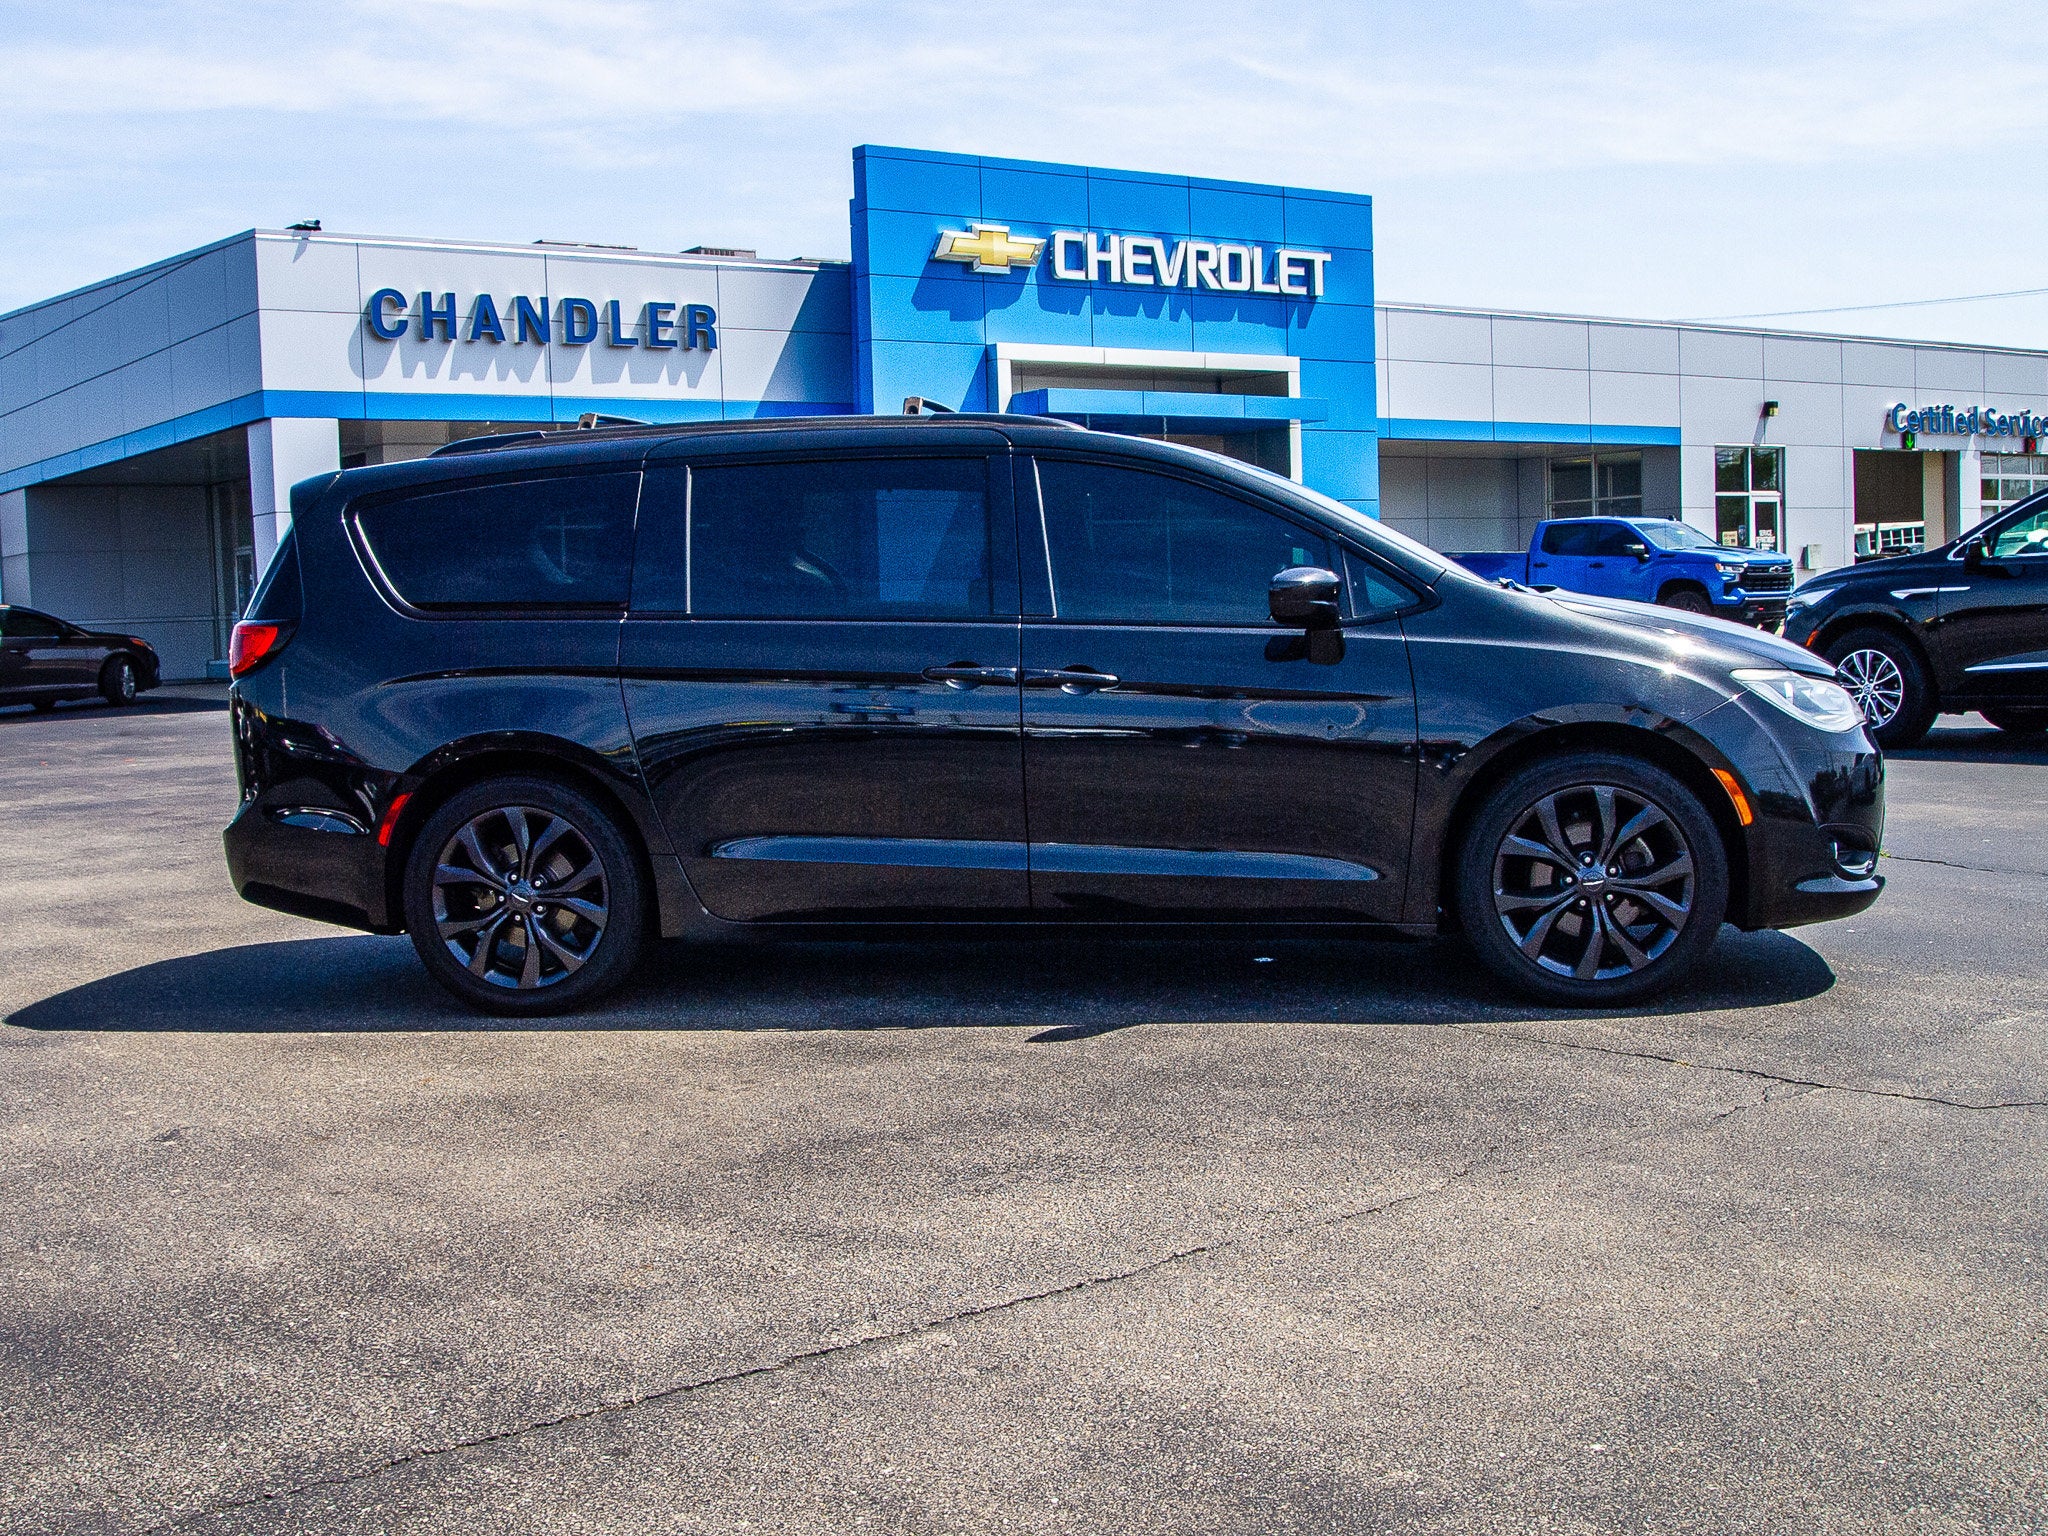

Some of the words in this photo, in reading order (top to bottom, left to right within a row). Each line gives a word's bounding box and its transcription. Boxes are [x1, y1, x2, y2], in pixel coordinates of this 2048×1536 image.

[1050, 230, 1332, 297] CHEVROLET
[369, 288, 718, 350] CHANDLER
[1890, 403, 1978, 434] Certified
[1984, 407, 2048, 437] Service
